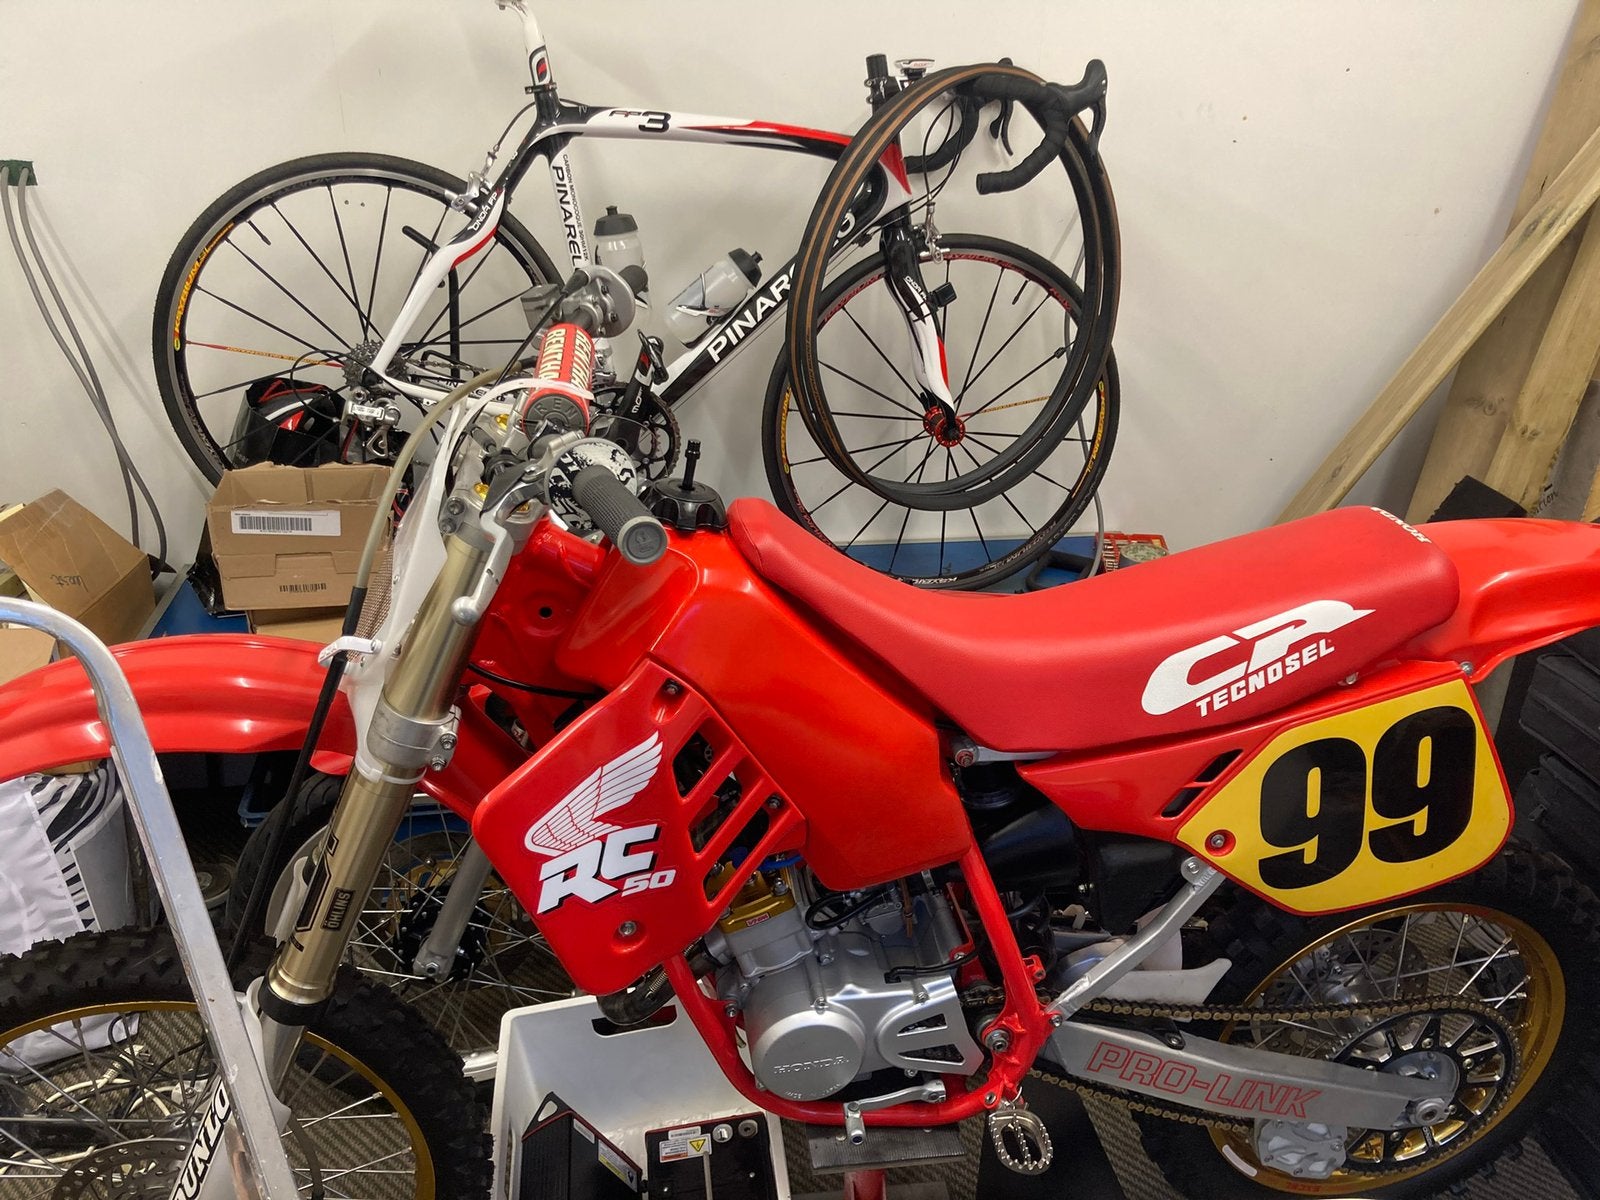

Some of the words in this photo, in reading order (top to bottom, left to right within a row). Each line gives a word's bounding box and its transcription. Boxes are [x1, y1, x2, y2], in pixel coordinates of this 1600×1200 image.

[552, 165, 582, 267] PINAREL
[538, 328, 566, 381] RENTHA
[571, 329, 593, 390] RENTHA
[1195, 638, 1336, 718] TECNOSEL
[1258, 705, 1477, 890] 99
[537, 823, 662, 915] RC
[621, 869, 677, 898] 50
[773, 1055, 850, 1074] HONDA
[1087, 1041, 1323, 1119] PRO-LINK
